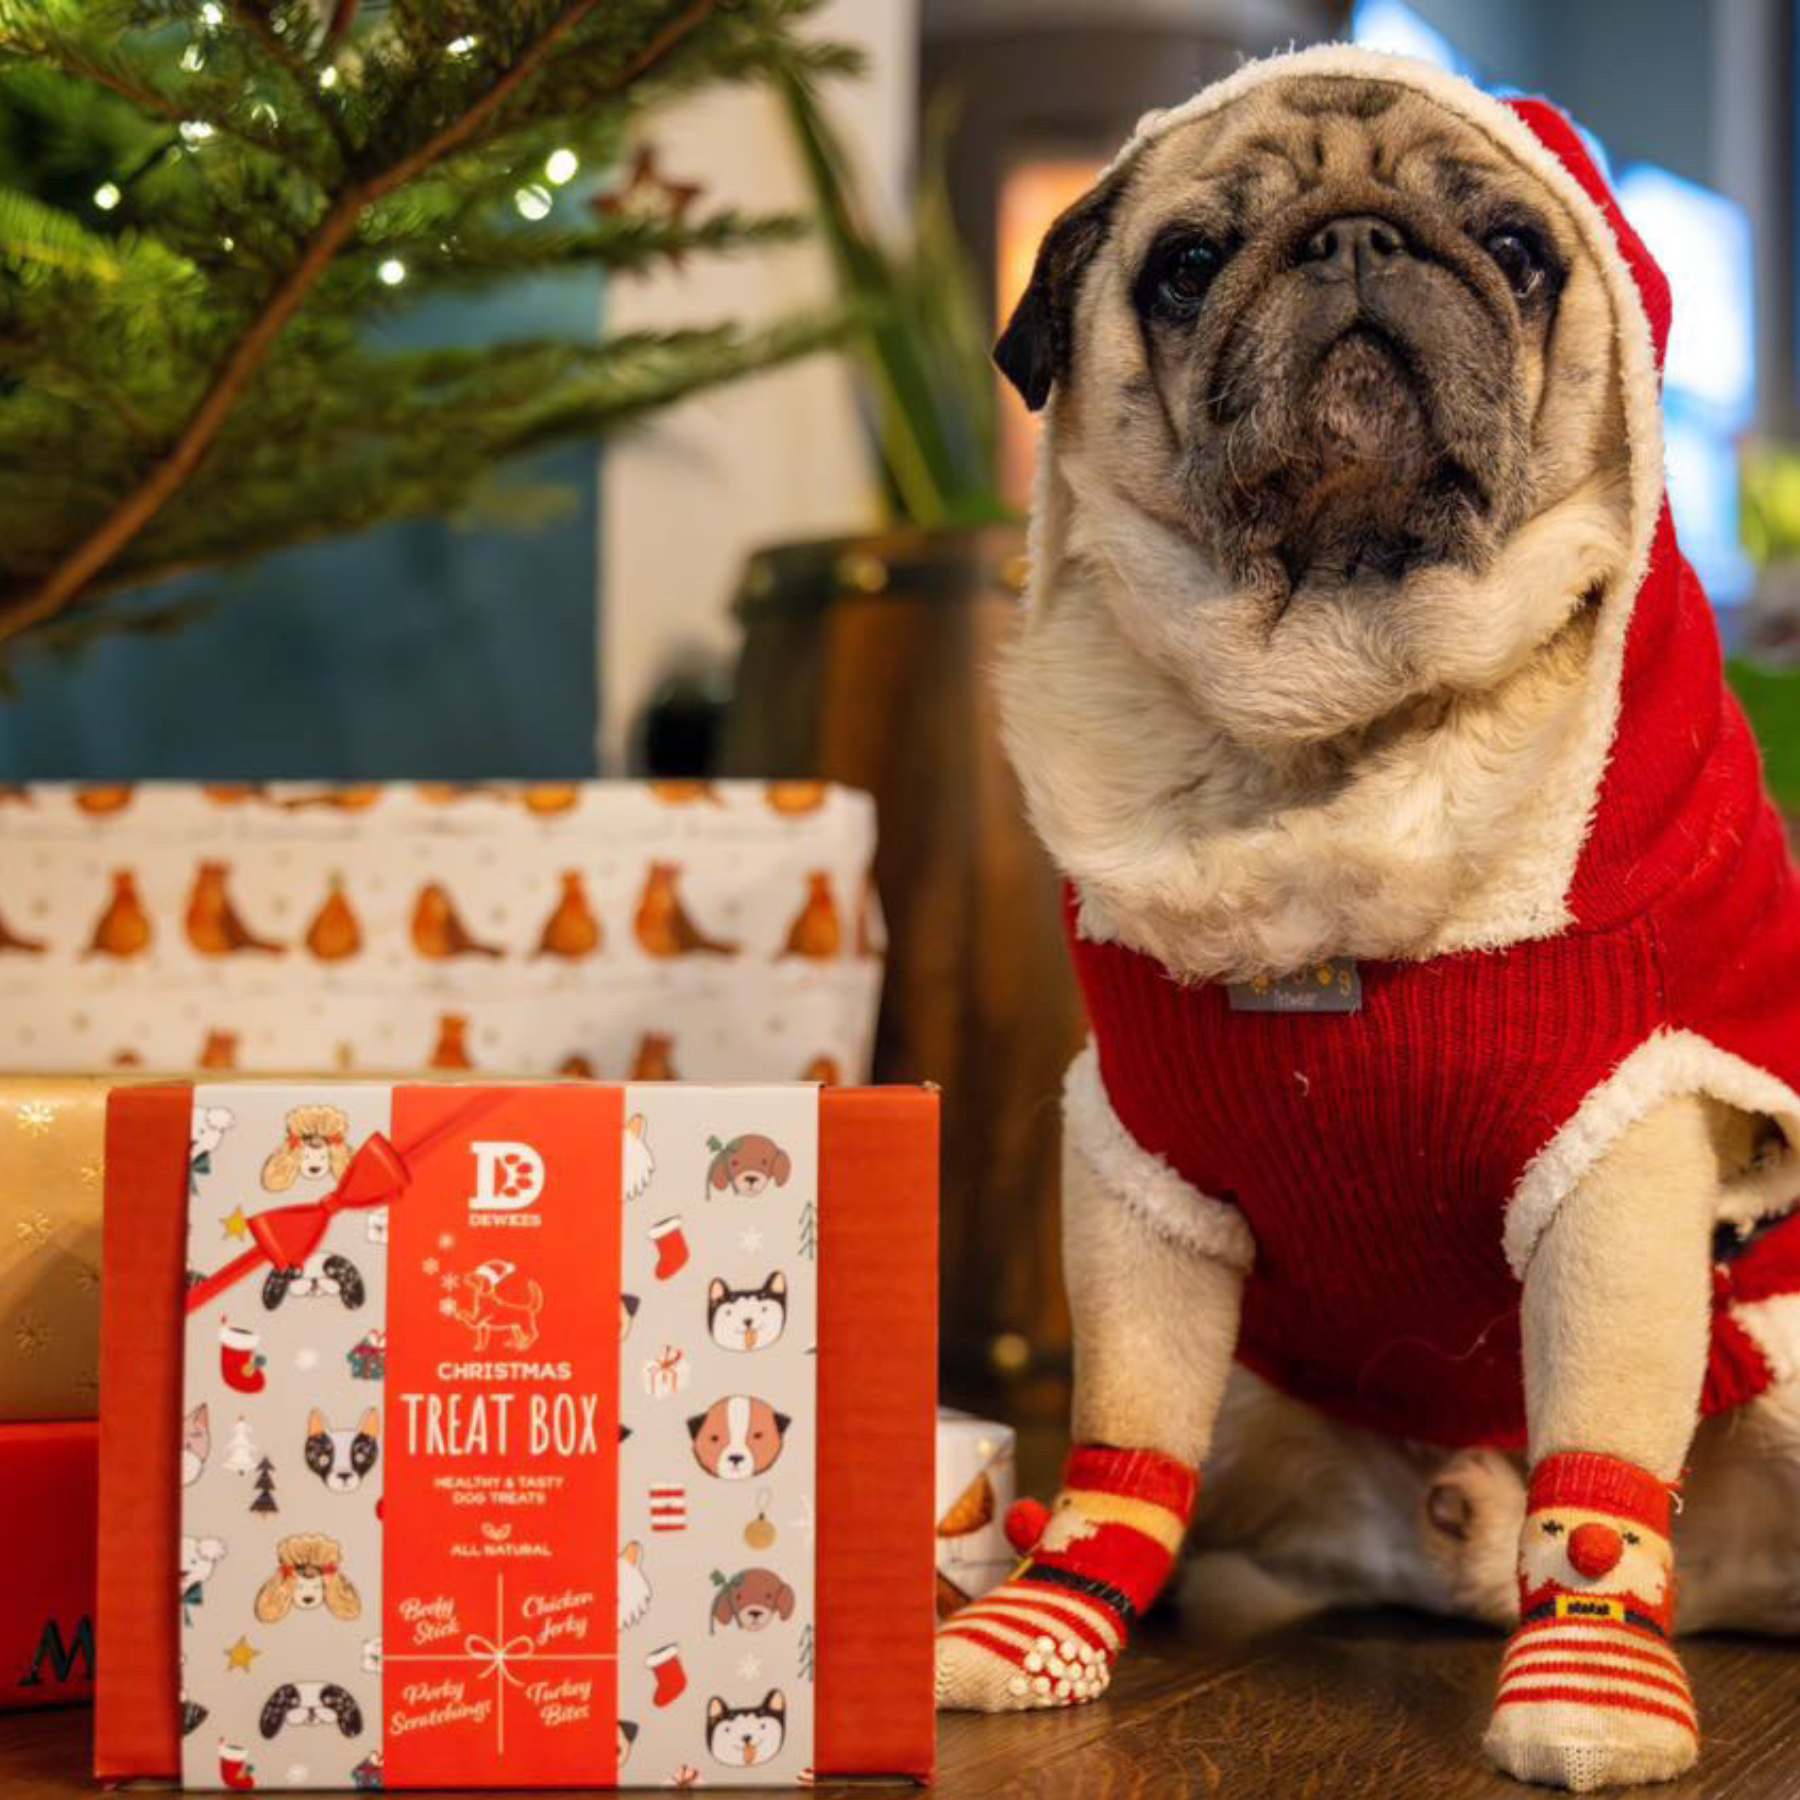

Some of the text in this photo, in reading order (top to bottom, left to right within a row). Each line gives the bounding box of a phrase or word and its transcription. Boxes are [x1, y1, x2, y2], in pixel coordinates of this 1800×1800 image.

[437, 1362, 572, 1380] CHRISTMAS
[401, 1394, 599, 1456] TREAT BOX
[434, 1475, 500, 1489] HEALTHY
[519, 1475, 564, 1489] TASTY
[452, 1491, 546, 1505] DOG TREATS
[451, 1544, 552, 1557] ALL NATURAL
[522, 1589, 593, 1618] Chicken
